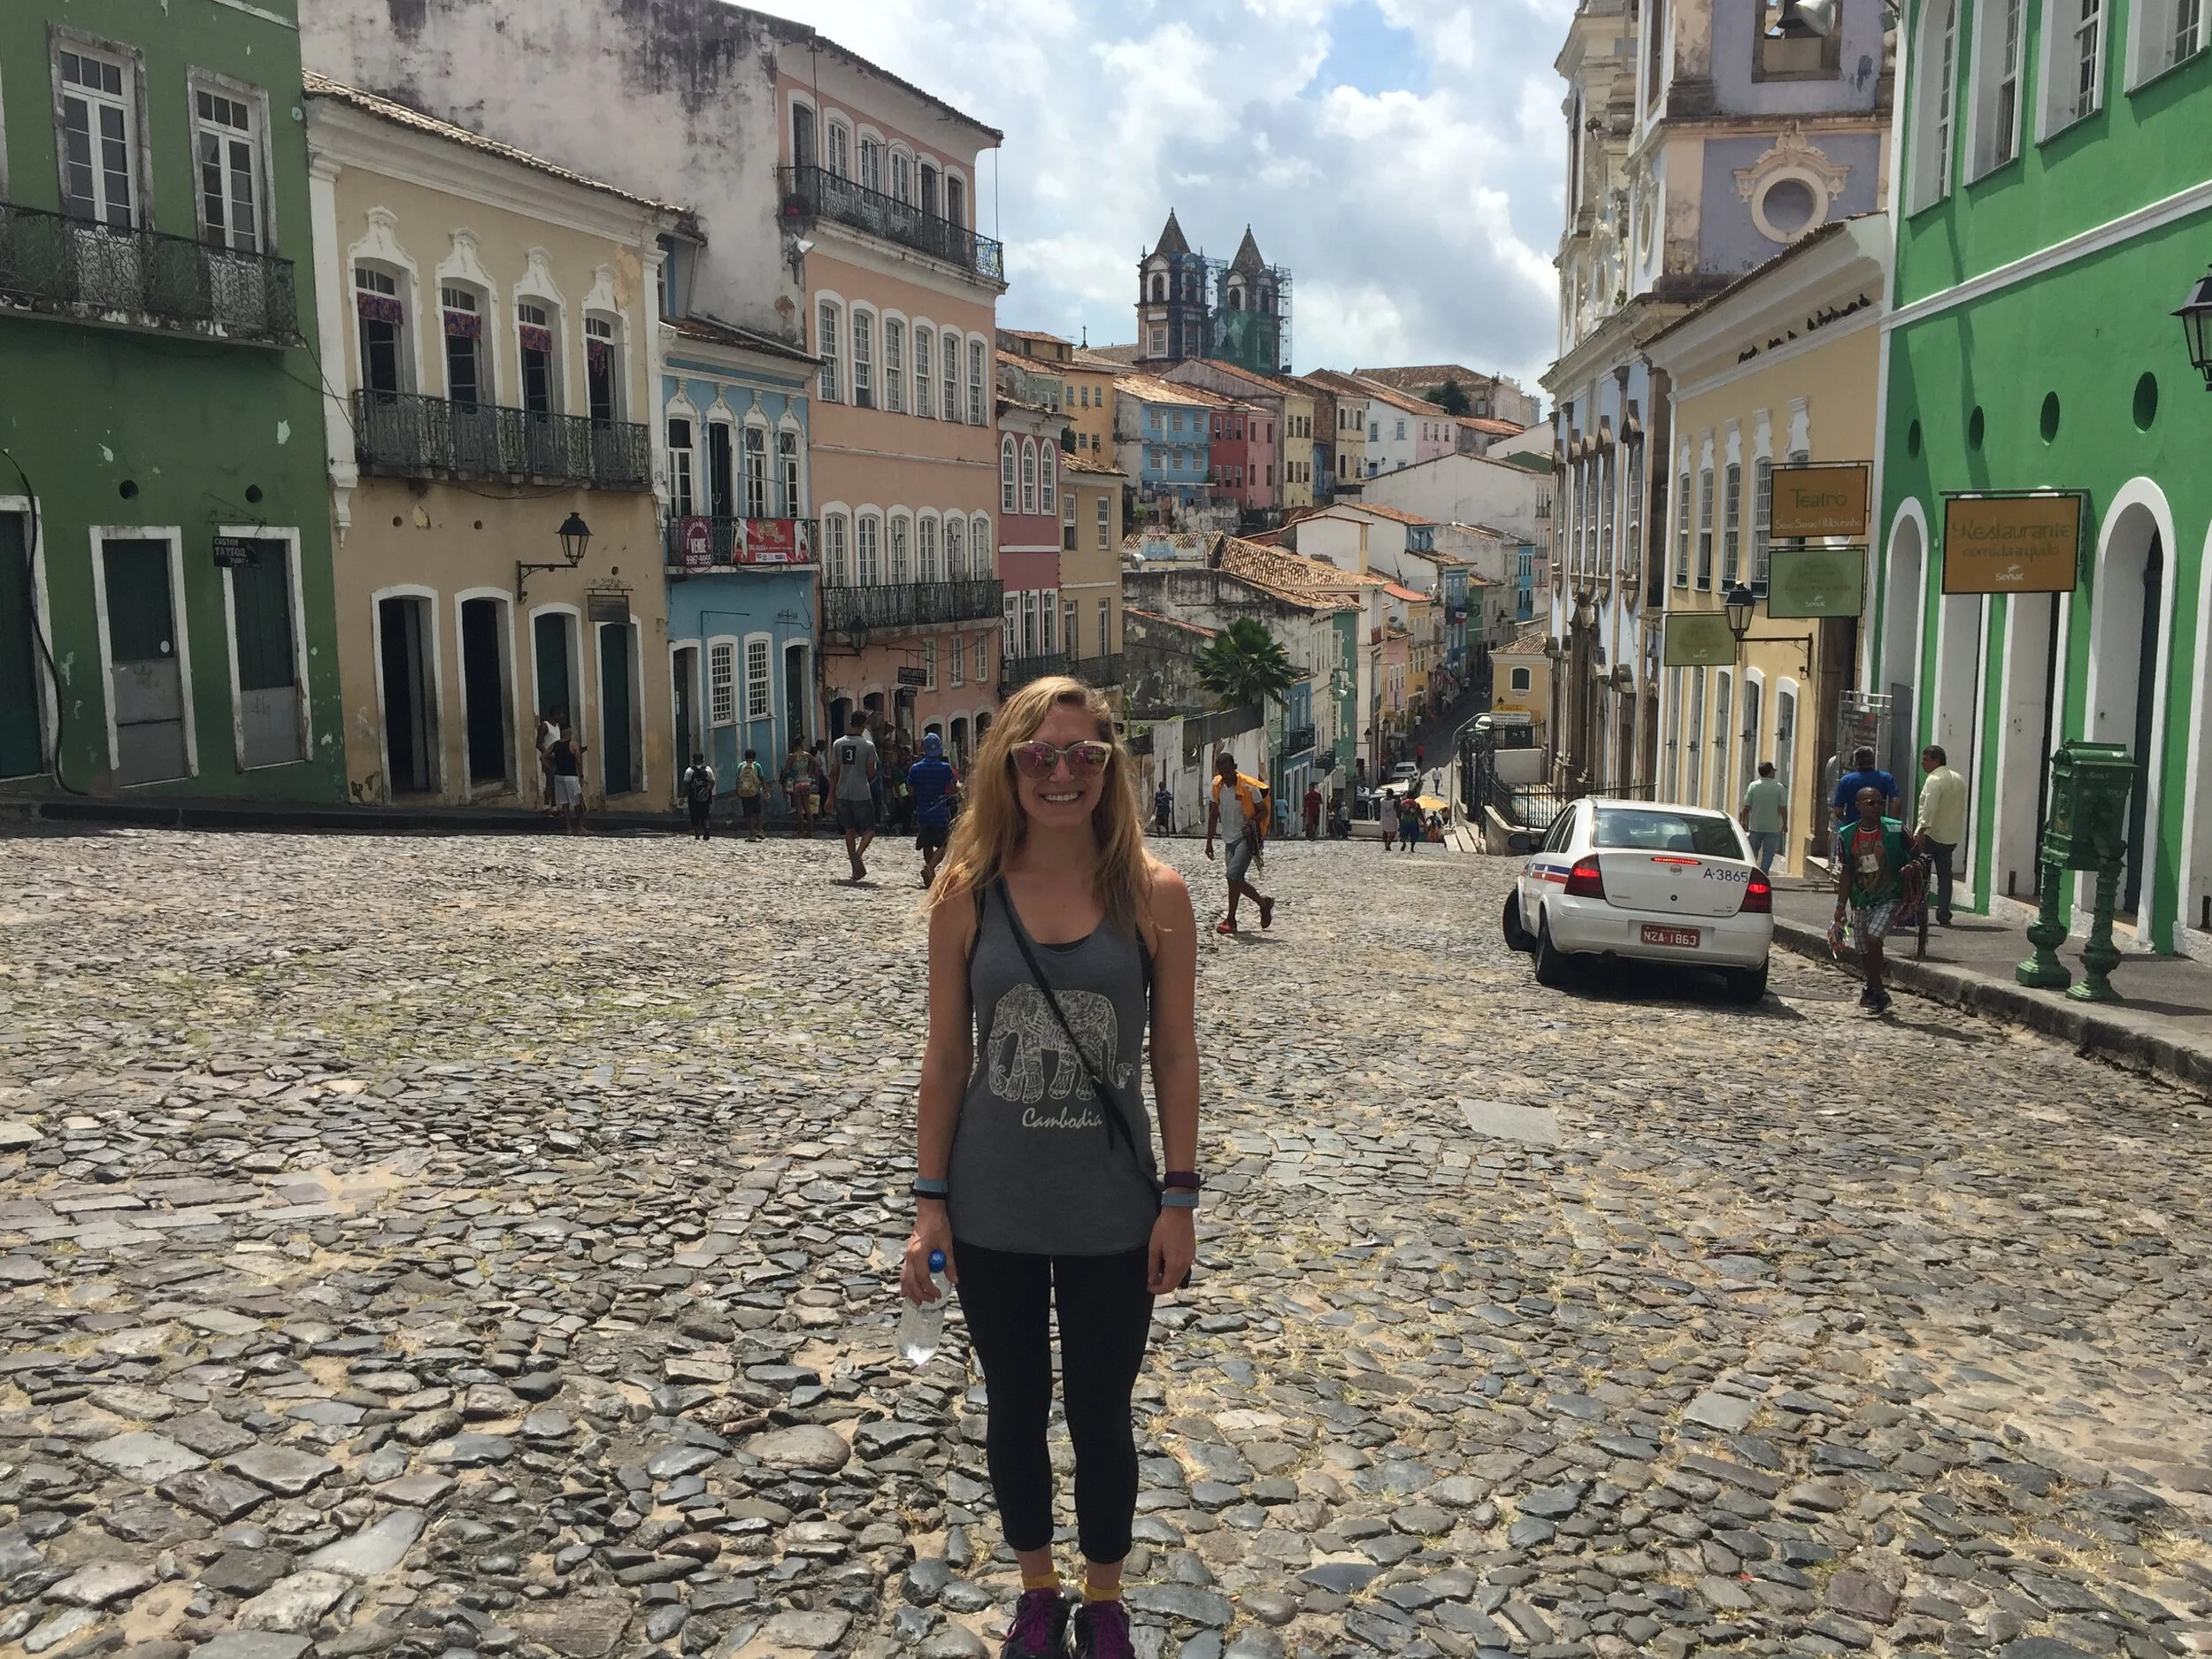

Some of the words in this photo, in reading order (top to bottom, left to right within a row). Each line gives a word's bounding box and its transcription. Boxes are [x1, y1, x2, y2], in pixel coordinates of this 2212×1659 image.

[1952, 520, 2072, 541] Restaurante
[846, 749, 854, 762] 3
[1022, 1105, 1103, 1129] Cambodia
